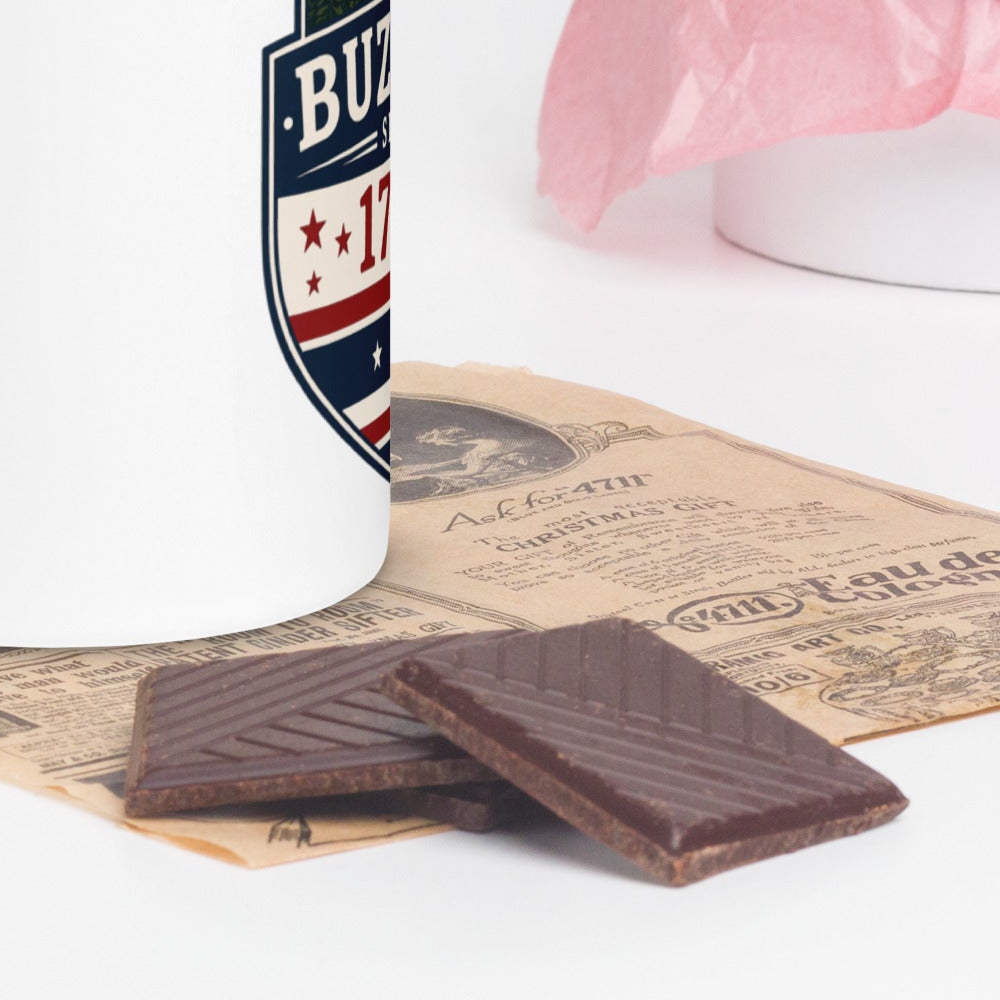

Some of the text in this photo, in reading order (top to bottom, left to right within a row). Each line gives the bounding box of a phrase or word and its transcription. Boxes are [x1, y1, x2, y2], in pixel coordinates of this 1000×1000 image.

[295, 10, 390, 152] BUZ
[360, 171, 390, 273] 17
[440, 498, 515, 533] Ask
[522, 490, 568, 509] for
[472, 535, 520, 546] The
[543, 510, 590, 528] most
[613, 495, 717, 510] acceptable
[495, 507, 665, 552] CHRISTMAS
[673, 500, 737, 512] GIFT
[453, 561, 507, 575] YOUR
[514, 549, 553, 561] GIFT
[801, 551, 1000, 592] Eau de
[334, 606, 424, 632] SIFTER
[419, 620, 458, 632] GIFT
[124, 645, 184, 659] THE
[791, 633, 843, 651] ART
[14, 676, 65, 690] man
[71, 658, 143, 679] would
[31, 659, 92, 676] what
[38, 687, 66, 695] to
